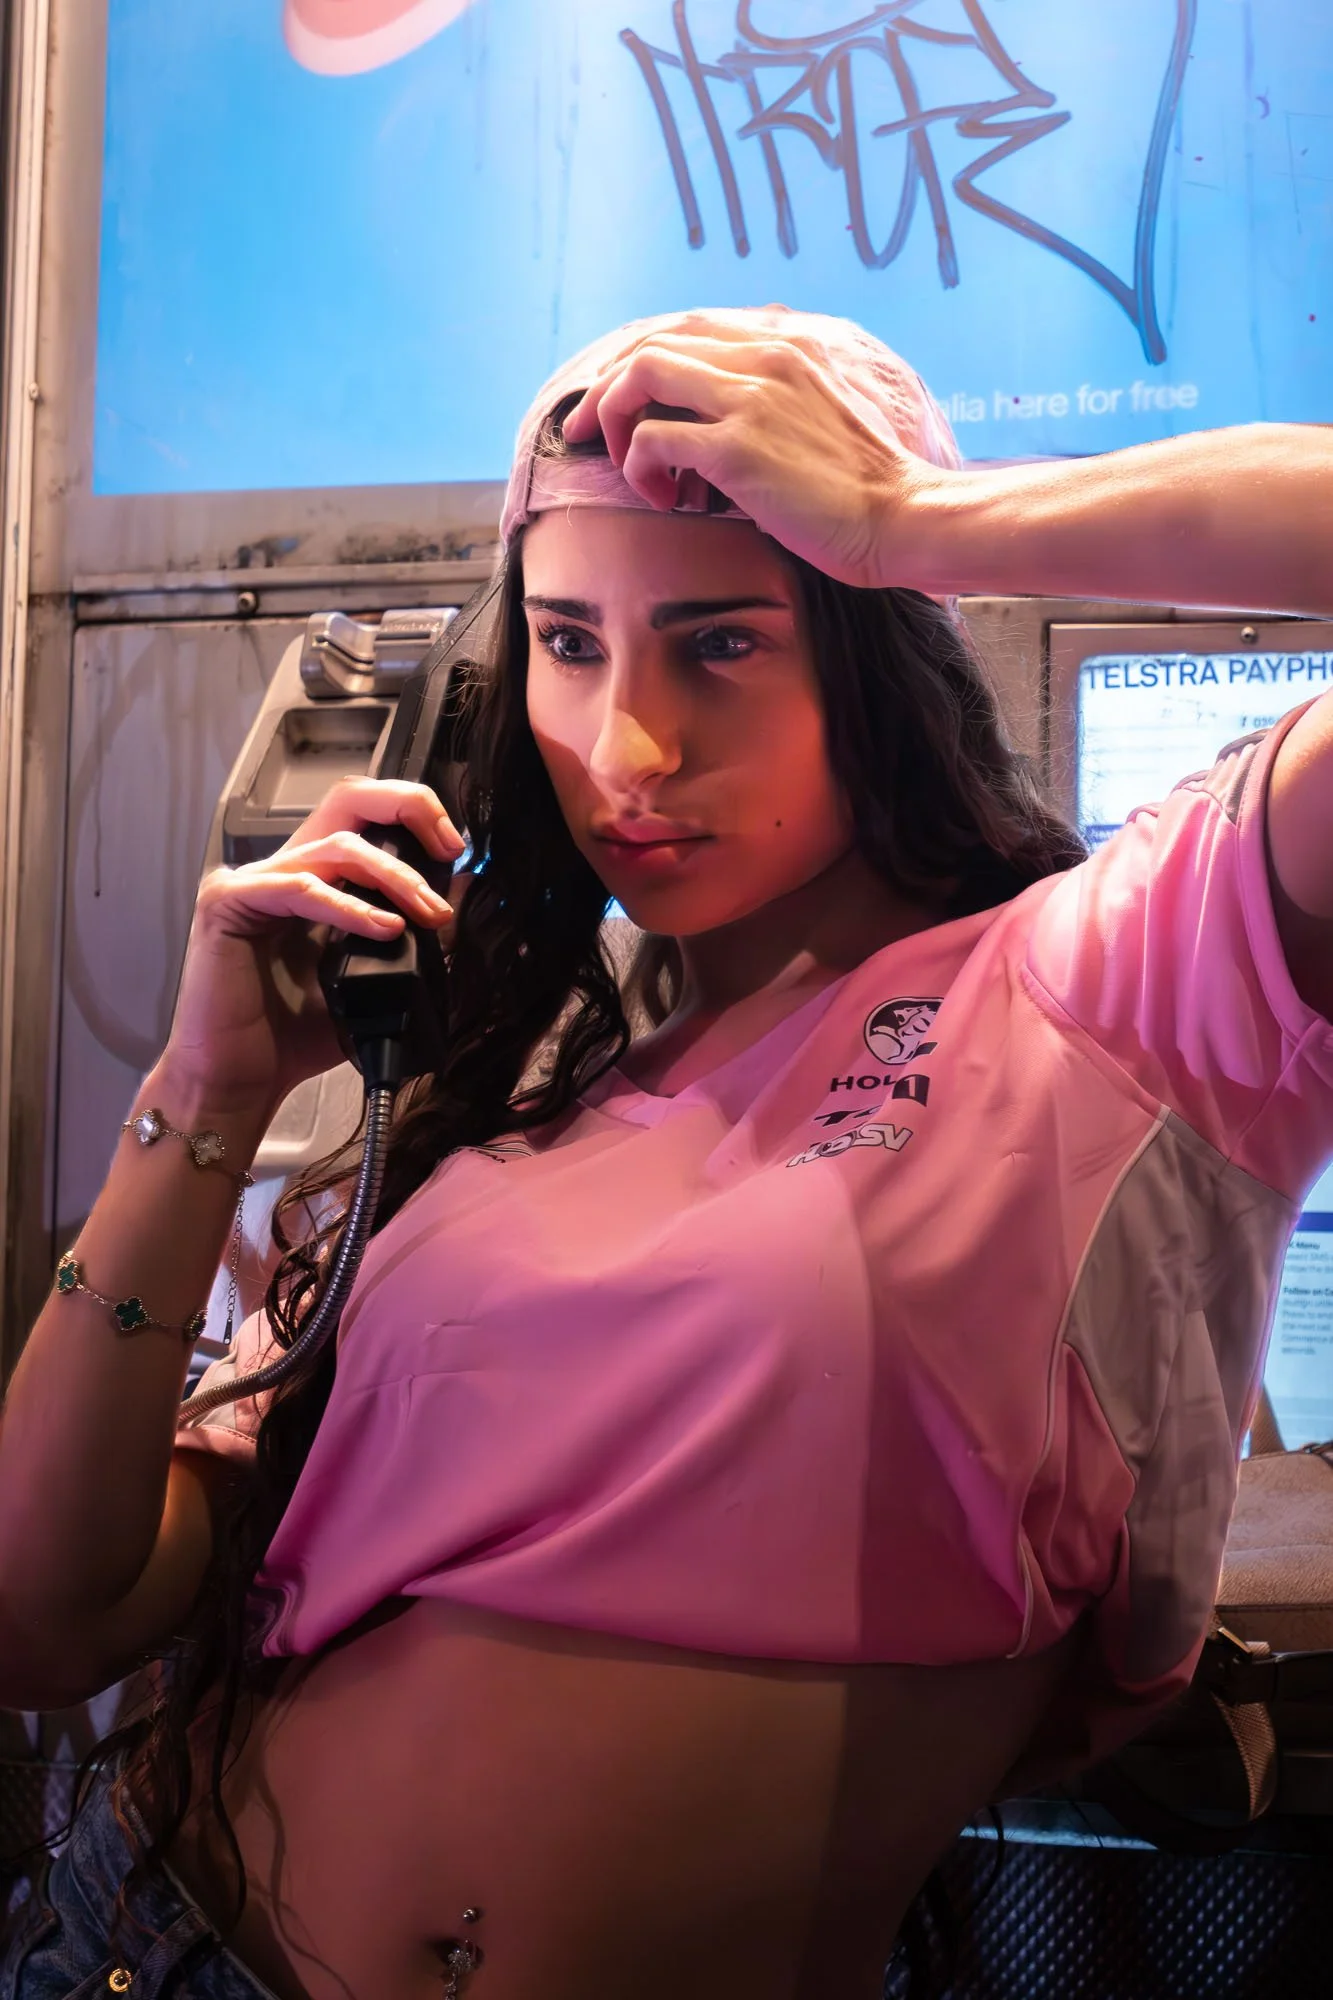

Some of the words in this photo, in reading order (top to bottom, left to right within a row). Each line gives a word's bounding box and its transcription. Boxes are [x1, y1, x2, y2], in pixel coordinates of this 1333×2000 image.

[993, 389, 1069, 420] here
[1076, 384, 1123, 415] for
[1130, 379, 1199, 413] free
[1084, 658, 1220, 690] TELSTRA
[1229, 656, 1333, 684] PAYPH
